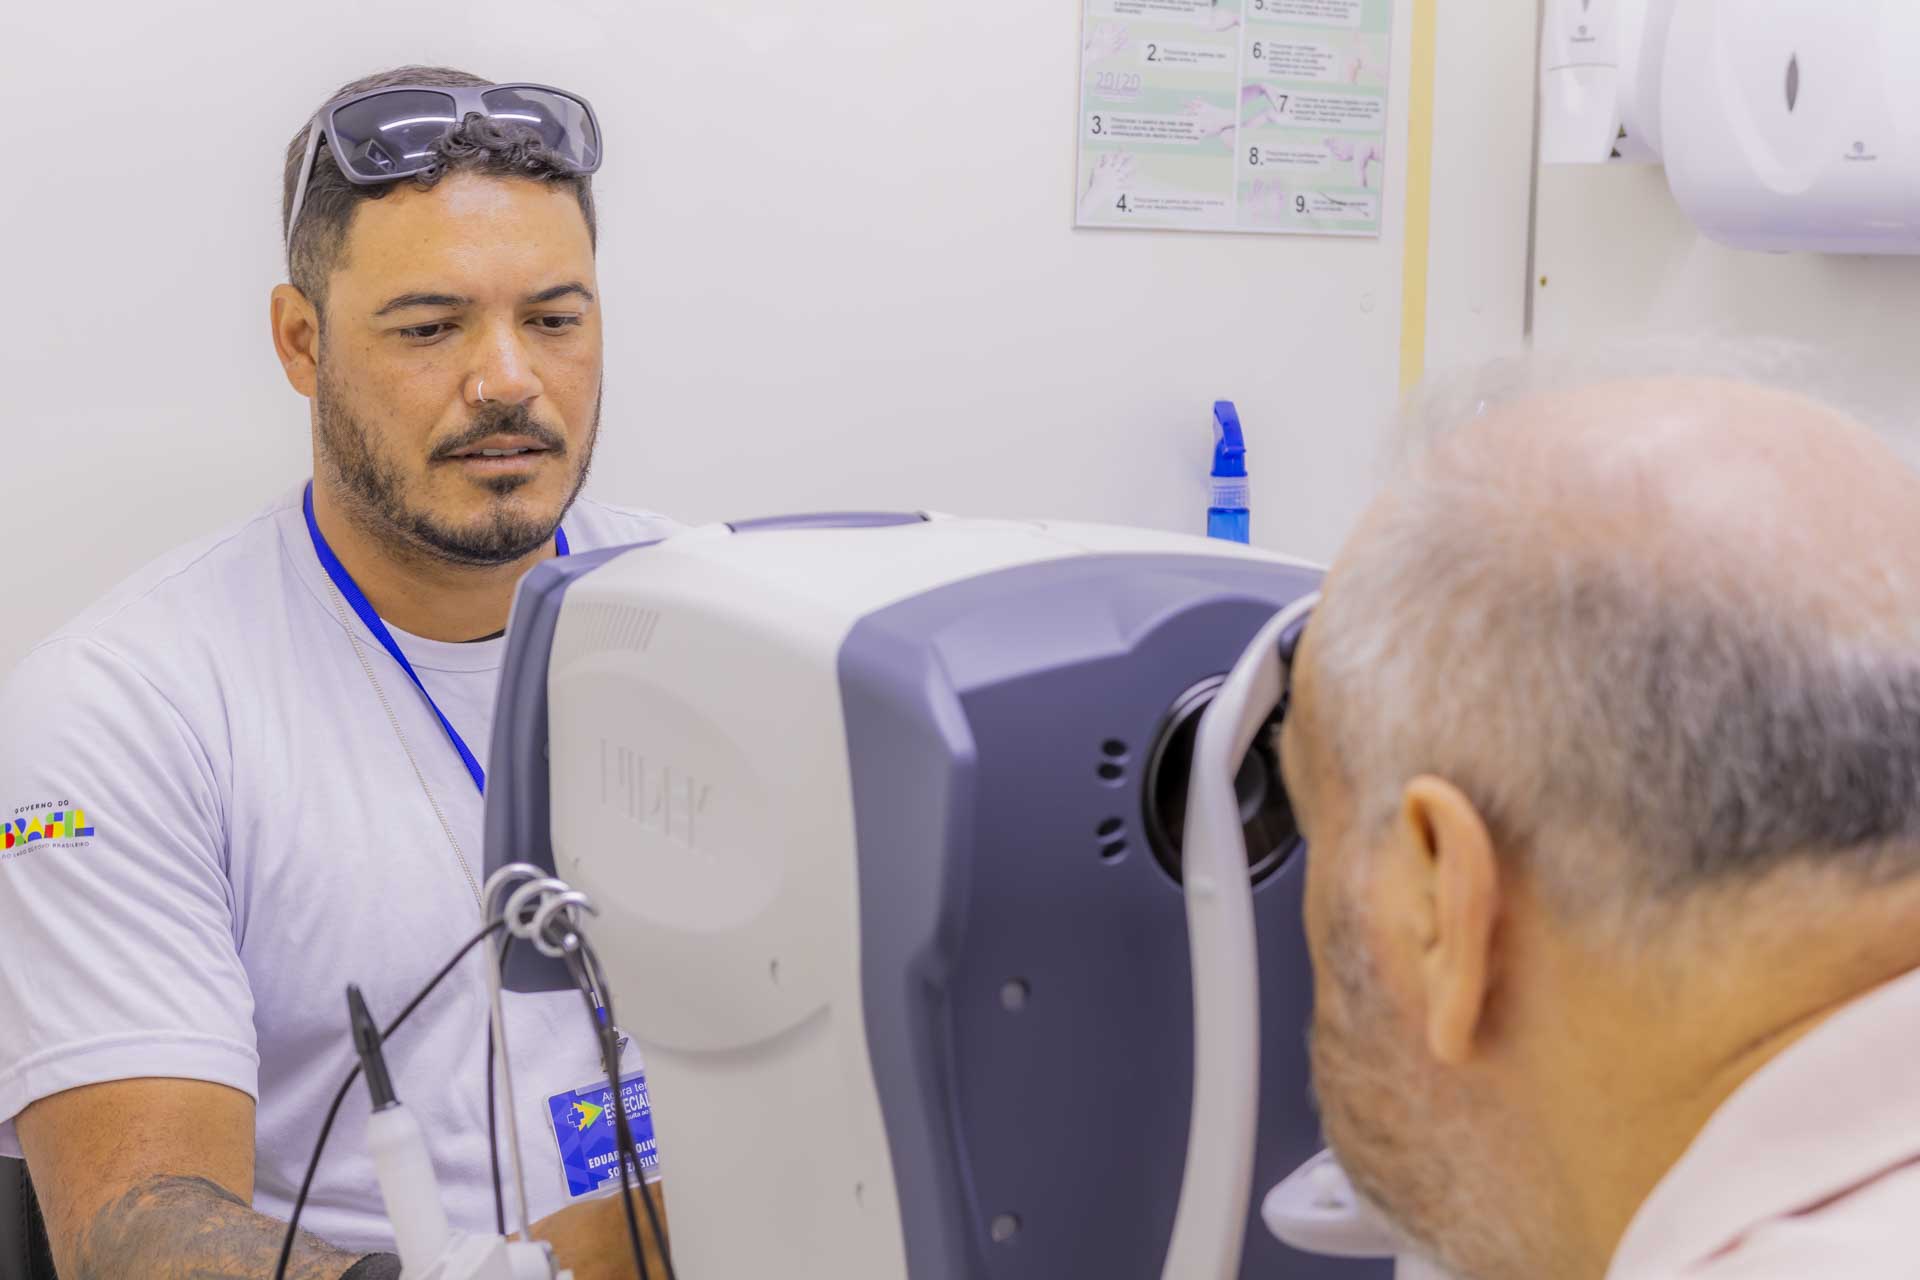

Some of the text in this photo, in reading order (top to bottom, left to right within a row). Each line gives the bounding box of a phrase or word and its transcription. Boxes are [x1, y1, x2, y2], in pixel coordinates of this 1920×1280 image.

[1147, 44, 1161, 61] 2.
[1252, 42, 1266, 60] 6.
[1279, 95, 1293, 114] 7.
[1091, 116, 1107, 135] 3.
[1249, 147, 1263, 166] 8.
[1116, 194, 1132, 213] 4.
[1295, 196, 1310, 214] 9.
[14, 799, 69, 815] GOVERNO DO
[0, 808, 95, 851] BRASIL
